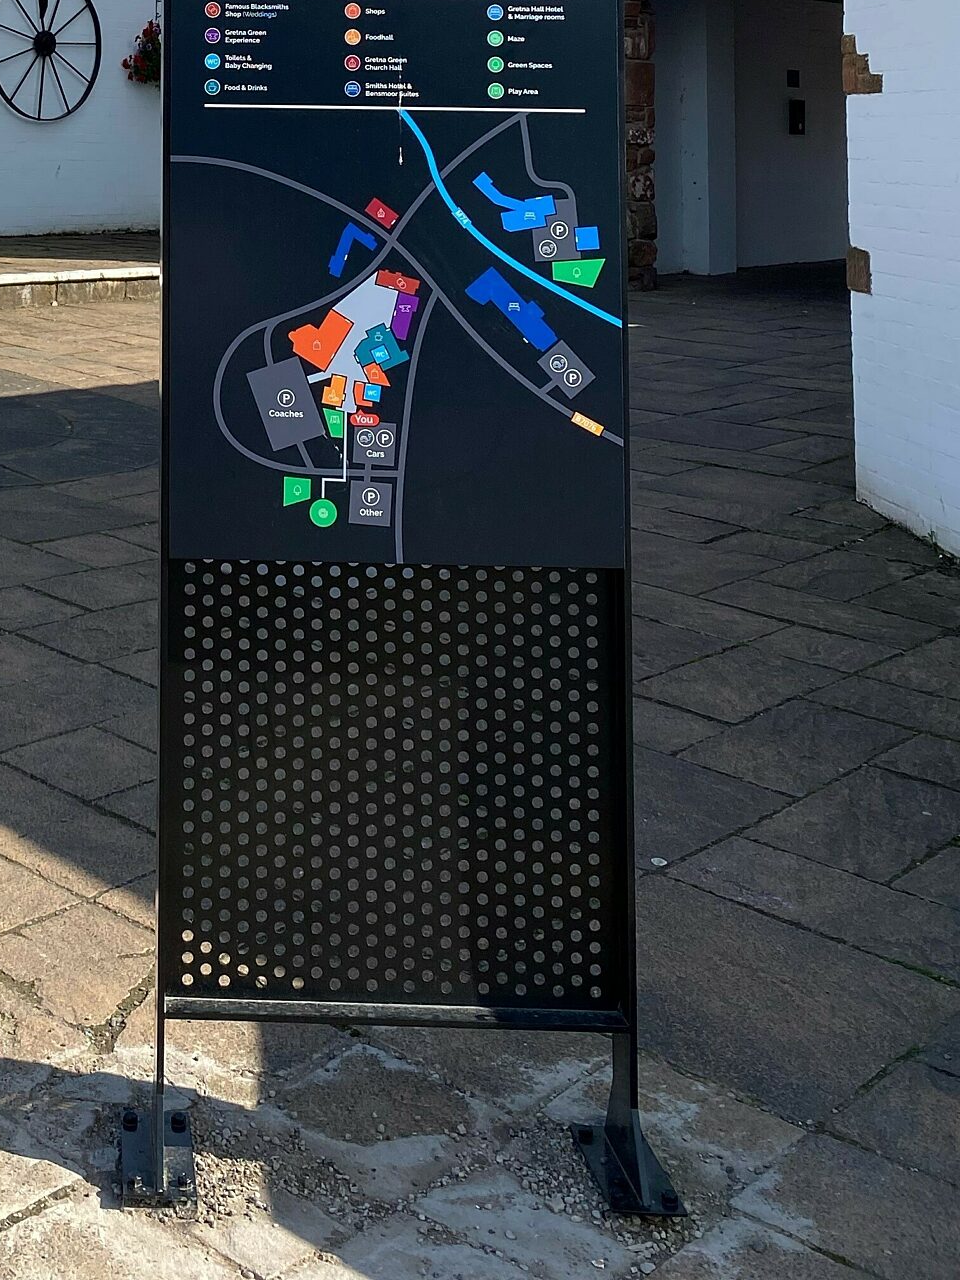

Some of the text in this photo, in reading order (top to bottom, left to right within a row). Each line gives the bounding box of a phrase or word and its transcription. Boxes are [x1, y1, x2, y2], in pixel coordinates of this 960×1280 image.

[508, 88, 522, 96] Play
[268, 409, 304, 418] Coaches
[354, 414, 374, 425] You
[366, 449, 385, 459] Cars
[359, 508, 384, 518] Other
